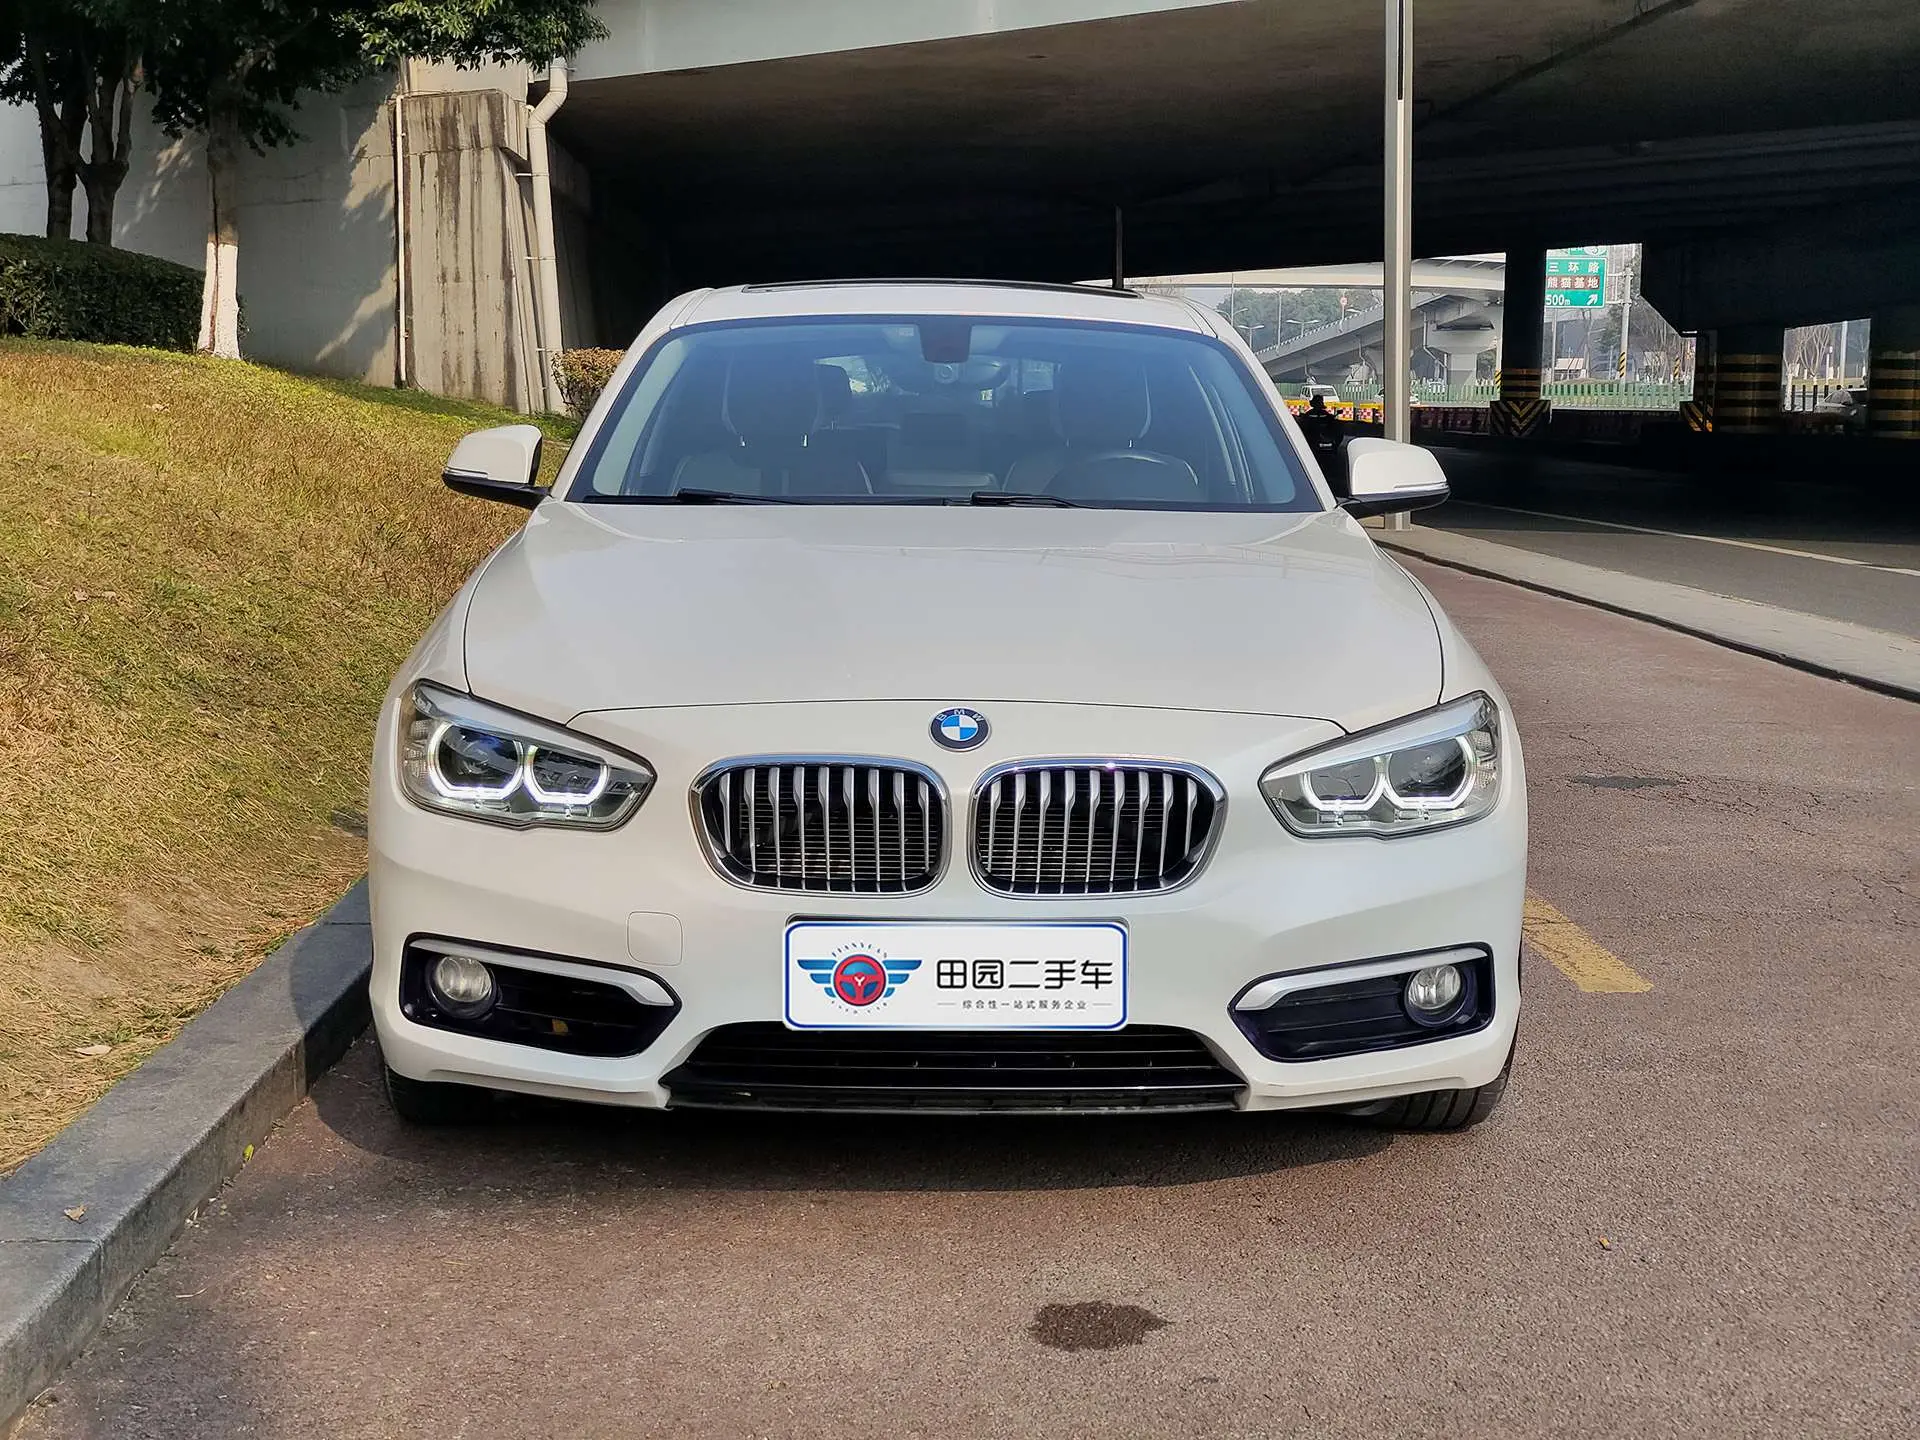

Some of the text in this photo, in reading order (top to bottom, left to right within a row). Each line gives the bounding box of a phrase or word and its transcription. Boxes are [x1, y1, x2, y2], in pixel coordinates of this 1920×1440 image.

[1548, 262, 1600, 273] 三环路
[1547, 276, 1599, 289] 熊猫基地
[1545, 294, 1571, 306] 500m
[936, 709, 984, 722] BMW
[937, 959, 1113, 990] 田园二手车
[962, 1000, 1087, 1010] 综合性一站式服务企业
